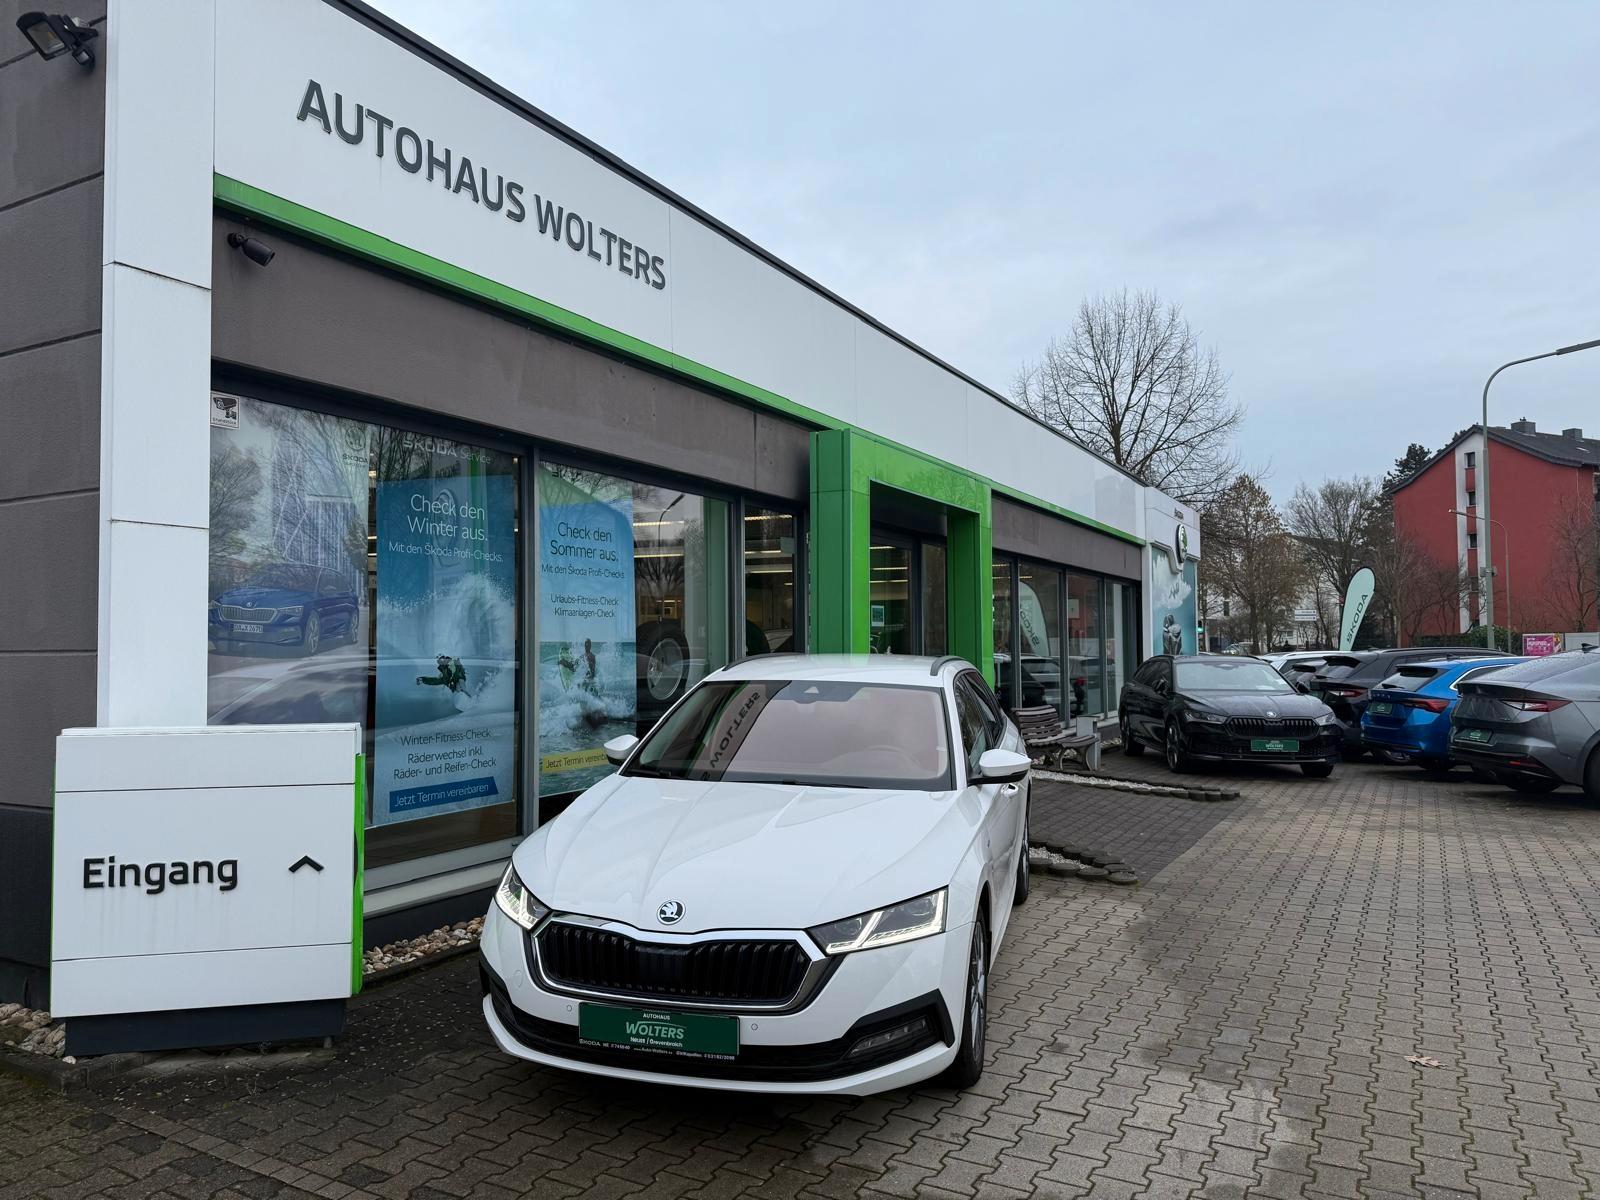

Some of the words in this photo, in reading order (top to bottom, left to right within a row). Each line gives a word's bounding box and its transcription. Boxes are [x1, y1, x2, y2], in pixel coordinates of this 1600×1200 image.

[297, 79, 526, 223] AUTOHAUS
[534, 193, 666, 291] WOLTERS
[410, 493, 456, 517] Check
[460, 502, 485, 520] den
[407, 515, 458, 537] Winter
[461, 526, 488, 541] aus.
[557, 521, 591, 541] Check
[593, 528, 612, 543] den
[389, 541, 405, 553] Mit
[406, 543, 422, 555] den
[424, 542, 452, 557] Škoda
[550, 539, 596, 558] Sommer
[600, 548, 619, 562] aus.
[541, 563, 553, 575] Mit
[554, 564, 567, 575] den
[568, 563, 587, 577] Škoda
[400, 729, 492, 746] Winter-Fitness-Check
[407, 747, 467, 764] Räderwechsel
[546, 758, 562, 769] Jetzt
[564, 754, 584, 766] Termin
[393, 766, 422, 780] Räder-
[425, 764, 442, 776] und
[444, 757, 497, 774] Reifen-Check
[394, 794, 416, 807] Jetzt
[417, 789, 446, 803] Termin
[446, 783, 489, 797] vereinbaren
[83, 856, 238, 895] Eingang
[642, 1012, 671, 1021] AUTOHAUS
[625, 1021, 685, 1040] WOLTERS
